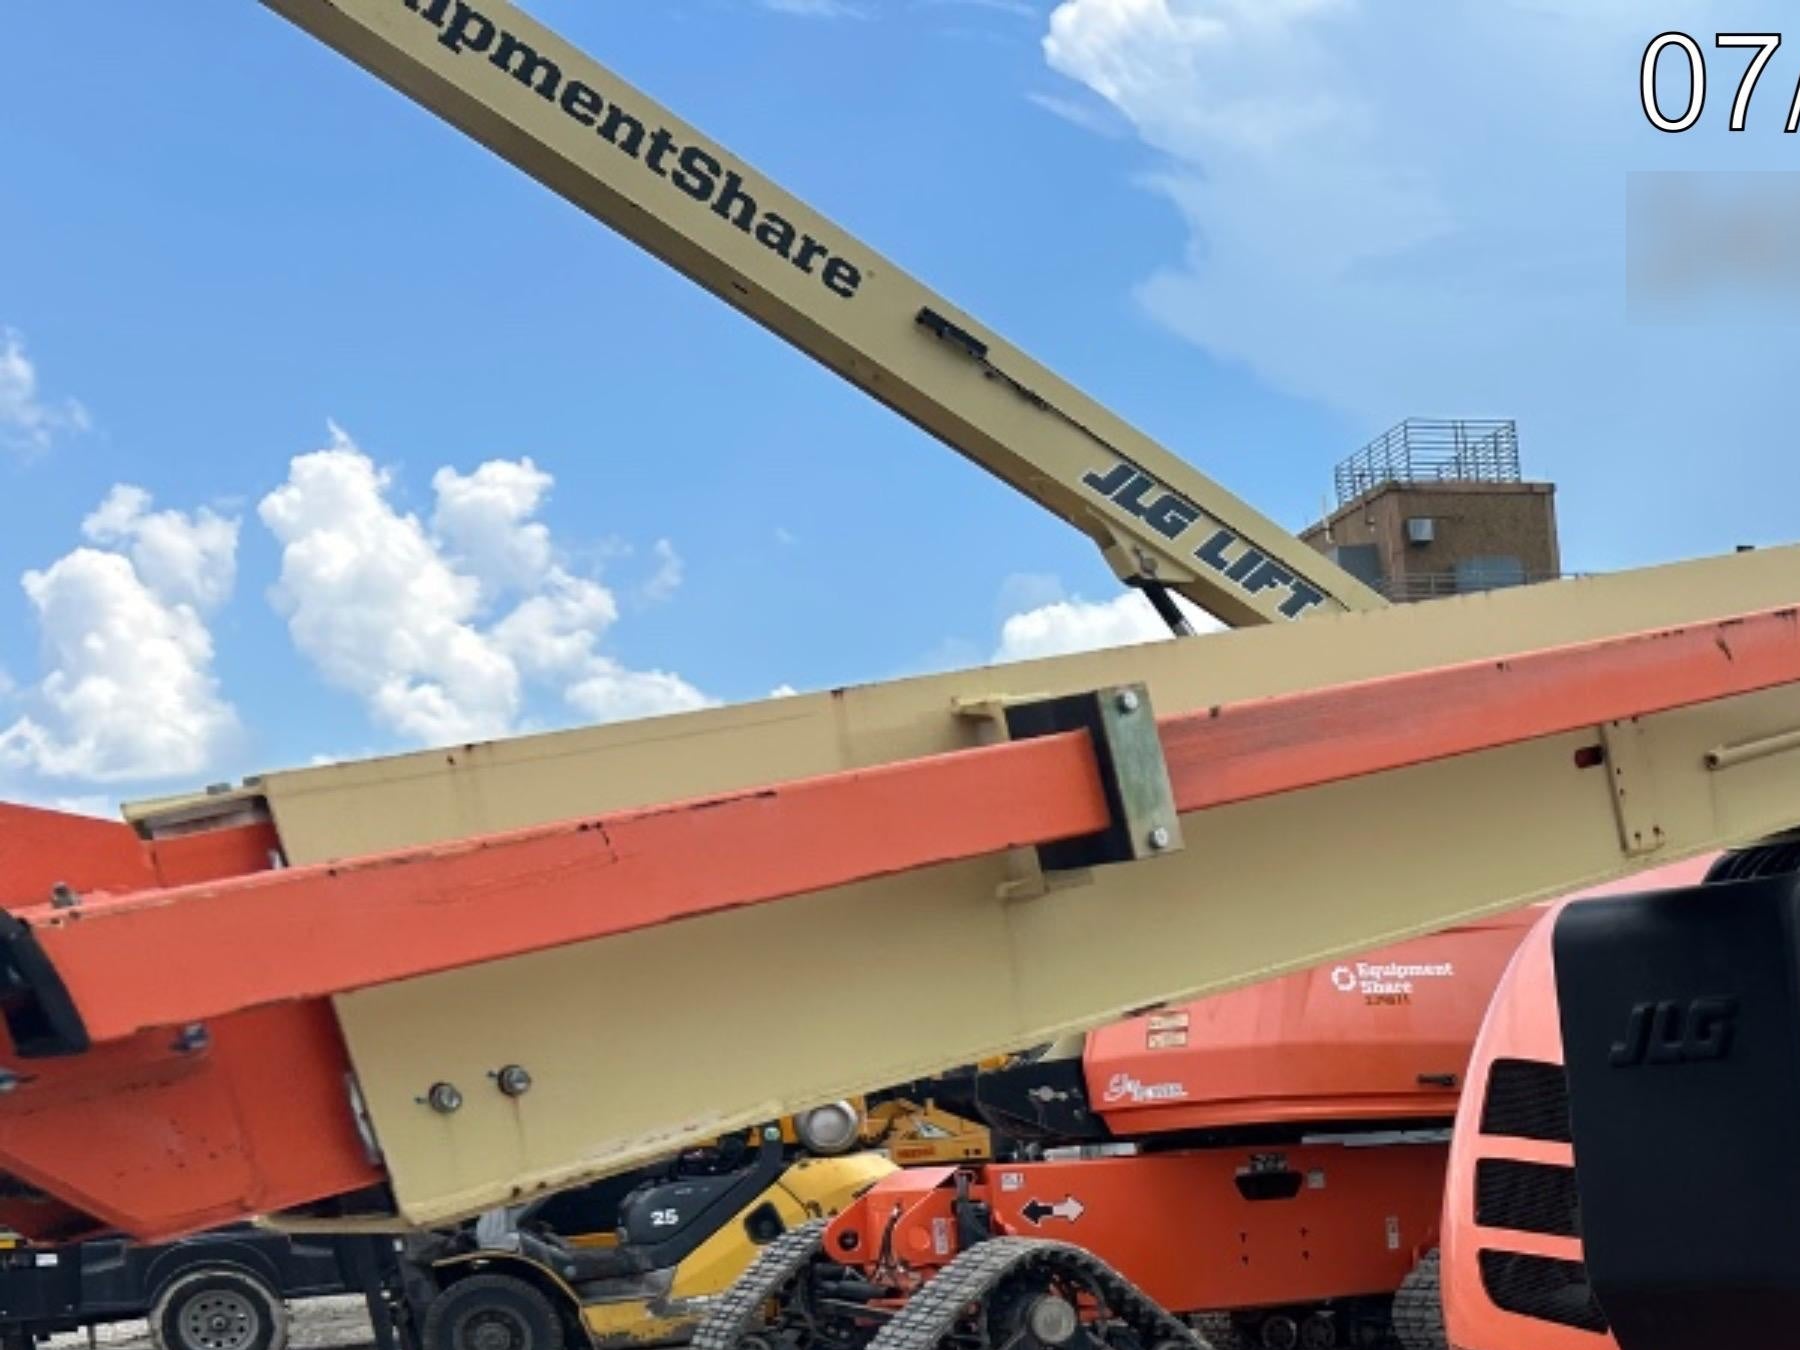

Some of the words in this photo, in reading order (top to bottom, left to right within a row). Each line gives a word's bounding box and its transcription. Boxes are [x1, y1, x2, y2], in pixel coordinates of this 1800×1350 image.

[404, 0, 861, 298] ipmentShare
[1081, 462, 1200, 540] JLG
[1194, 528, 1326, 620] LIFT
[1608, 994, 1741, 1068] JLG
[650, 1208, 679, 1226] 25
